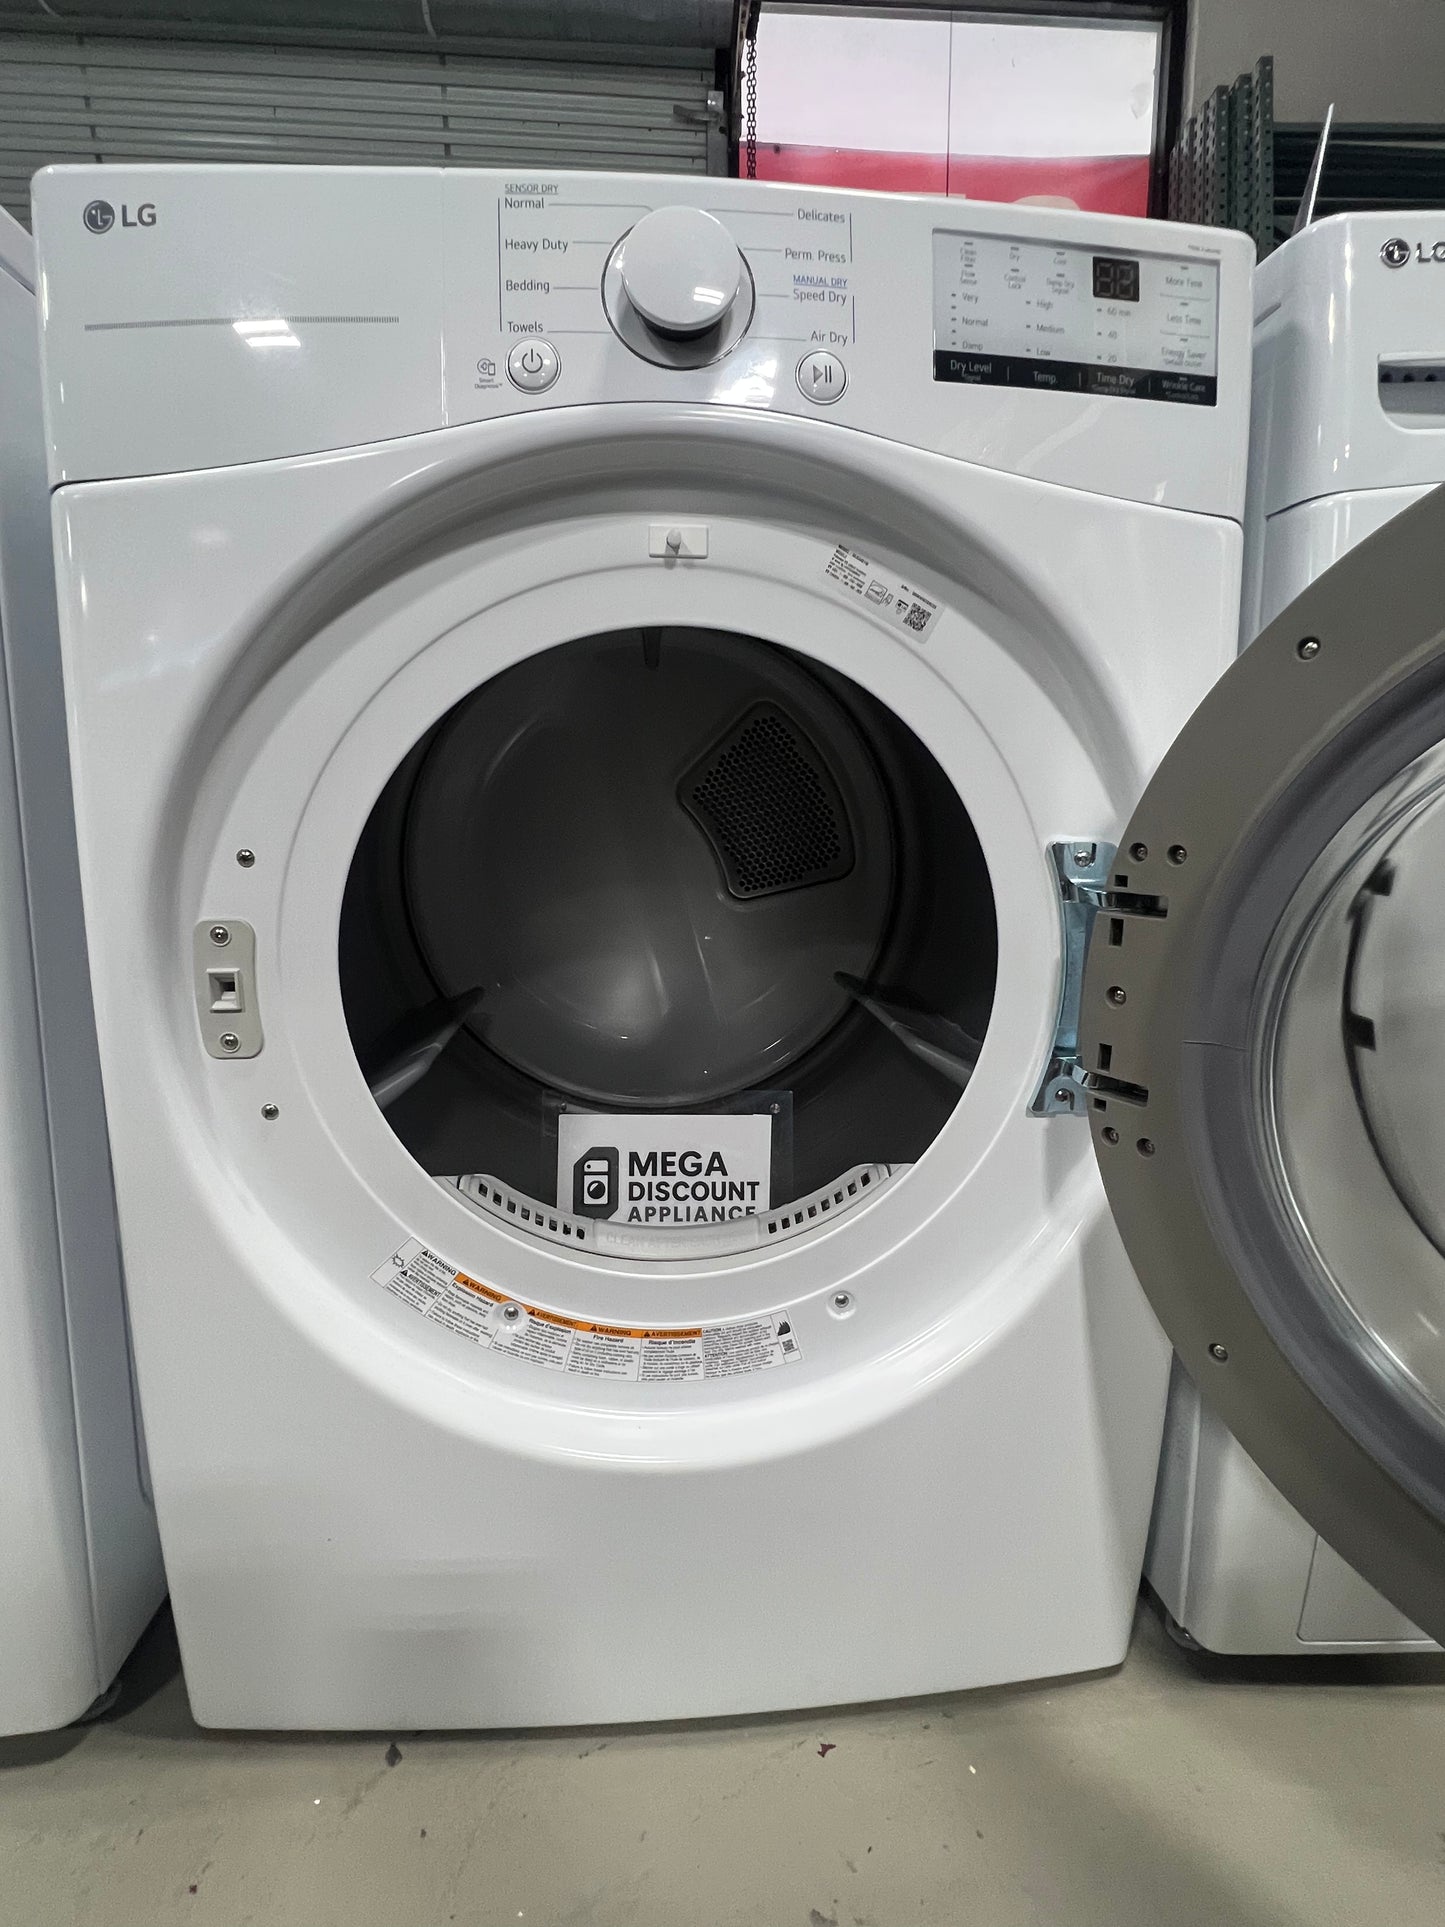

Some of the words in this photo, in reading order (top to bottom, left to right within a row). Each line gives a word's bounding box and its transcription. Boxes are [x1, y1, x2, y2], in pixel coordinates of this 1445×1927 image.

[504, 183, 539, 194] SENSOR
[541, 184, 559, 194] DRY
[504, 197, 545, 209] Normal
[121, 203, 157, 227] LG
[797, 207, 846, 223] Delicates
[505, 238, 539, 253] Heavy
[542, 238, 568, 253] Duty
[817, 249, 847, 264] Press
[506, 280, 550, 294] Bedding
[793, 274, 828, 287] MANUAL
[830, 277, 848, 289] DRY
[793, 288, 826, 304] Speed
[828, 290, 847, 307] Dry
[962, 292, 979, 304] Very
[1036, 300, 1054, 311] High
[507, 321, 544, 333] Towels
[961, 316, 989, 327] Normal
[1036, 324, 1065, 335] Medium
[810, 330, 826, 342] Air
[829, 331, 848, 348] Dry
[962, 341, 984, 352] Damp
[1036, 347, 1051, 357] Low
[950, 359, 967, 374] Dry
[968, 361, 992, 374] Level
[1097, 372, 1117, 384] Time
[1119, 374, 1135, 387] Dry
[628, 1151, 729, 1177] MEGA
[628, 1180, 761, 1202] DISCOUNT
[427, 1254, 457, 1277] WARNING
[469, 1282, 502, 1301] WARNING
[598, 1326, 631, 1336] WARNING
